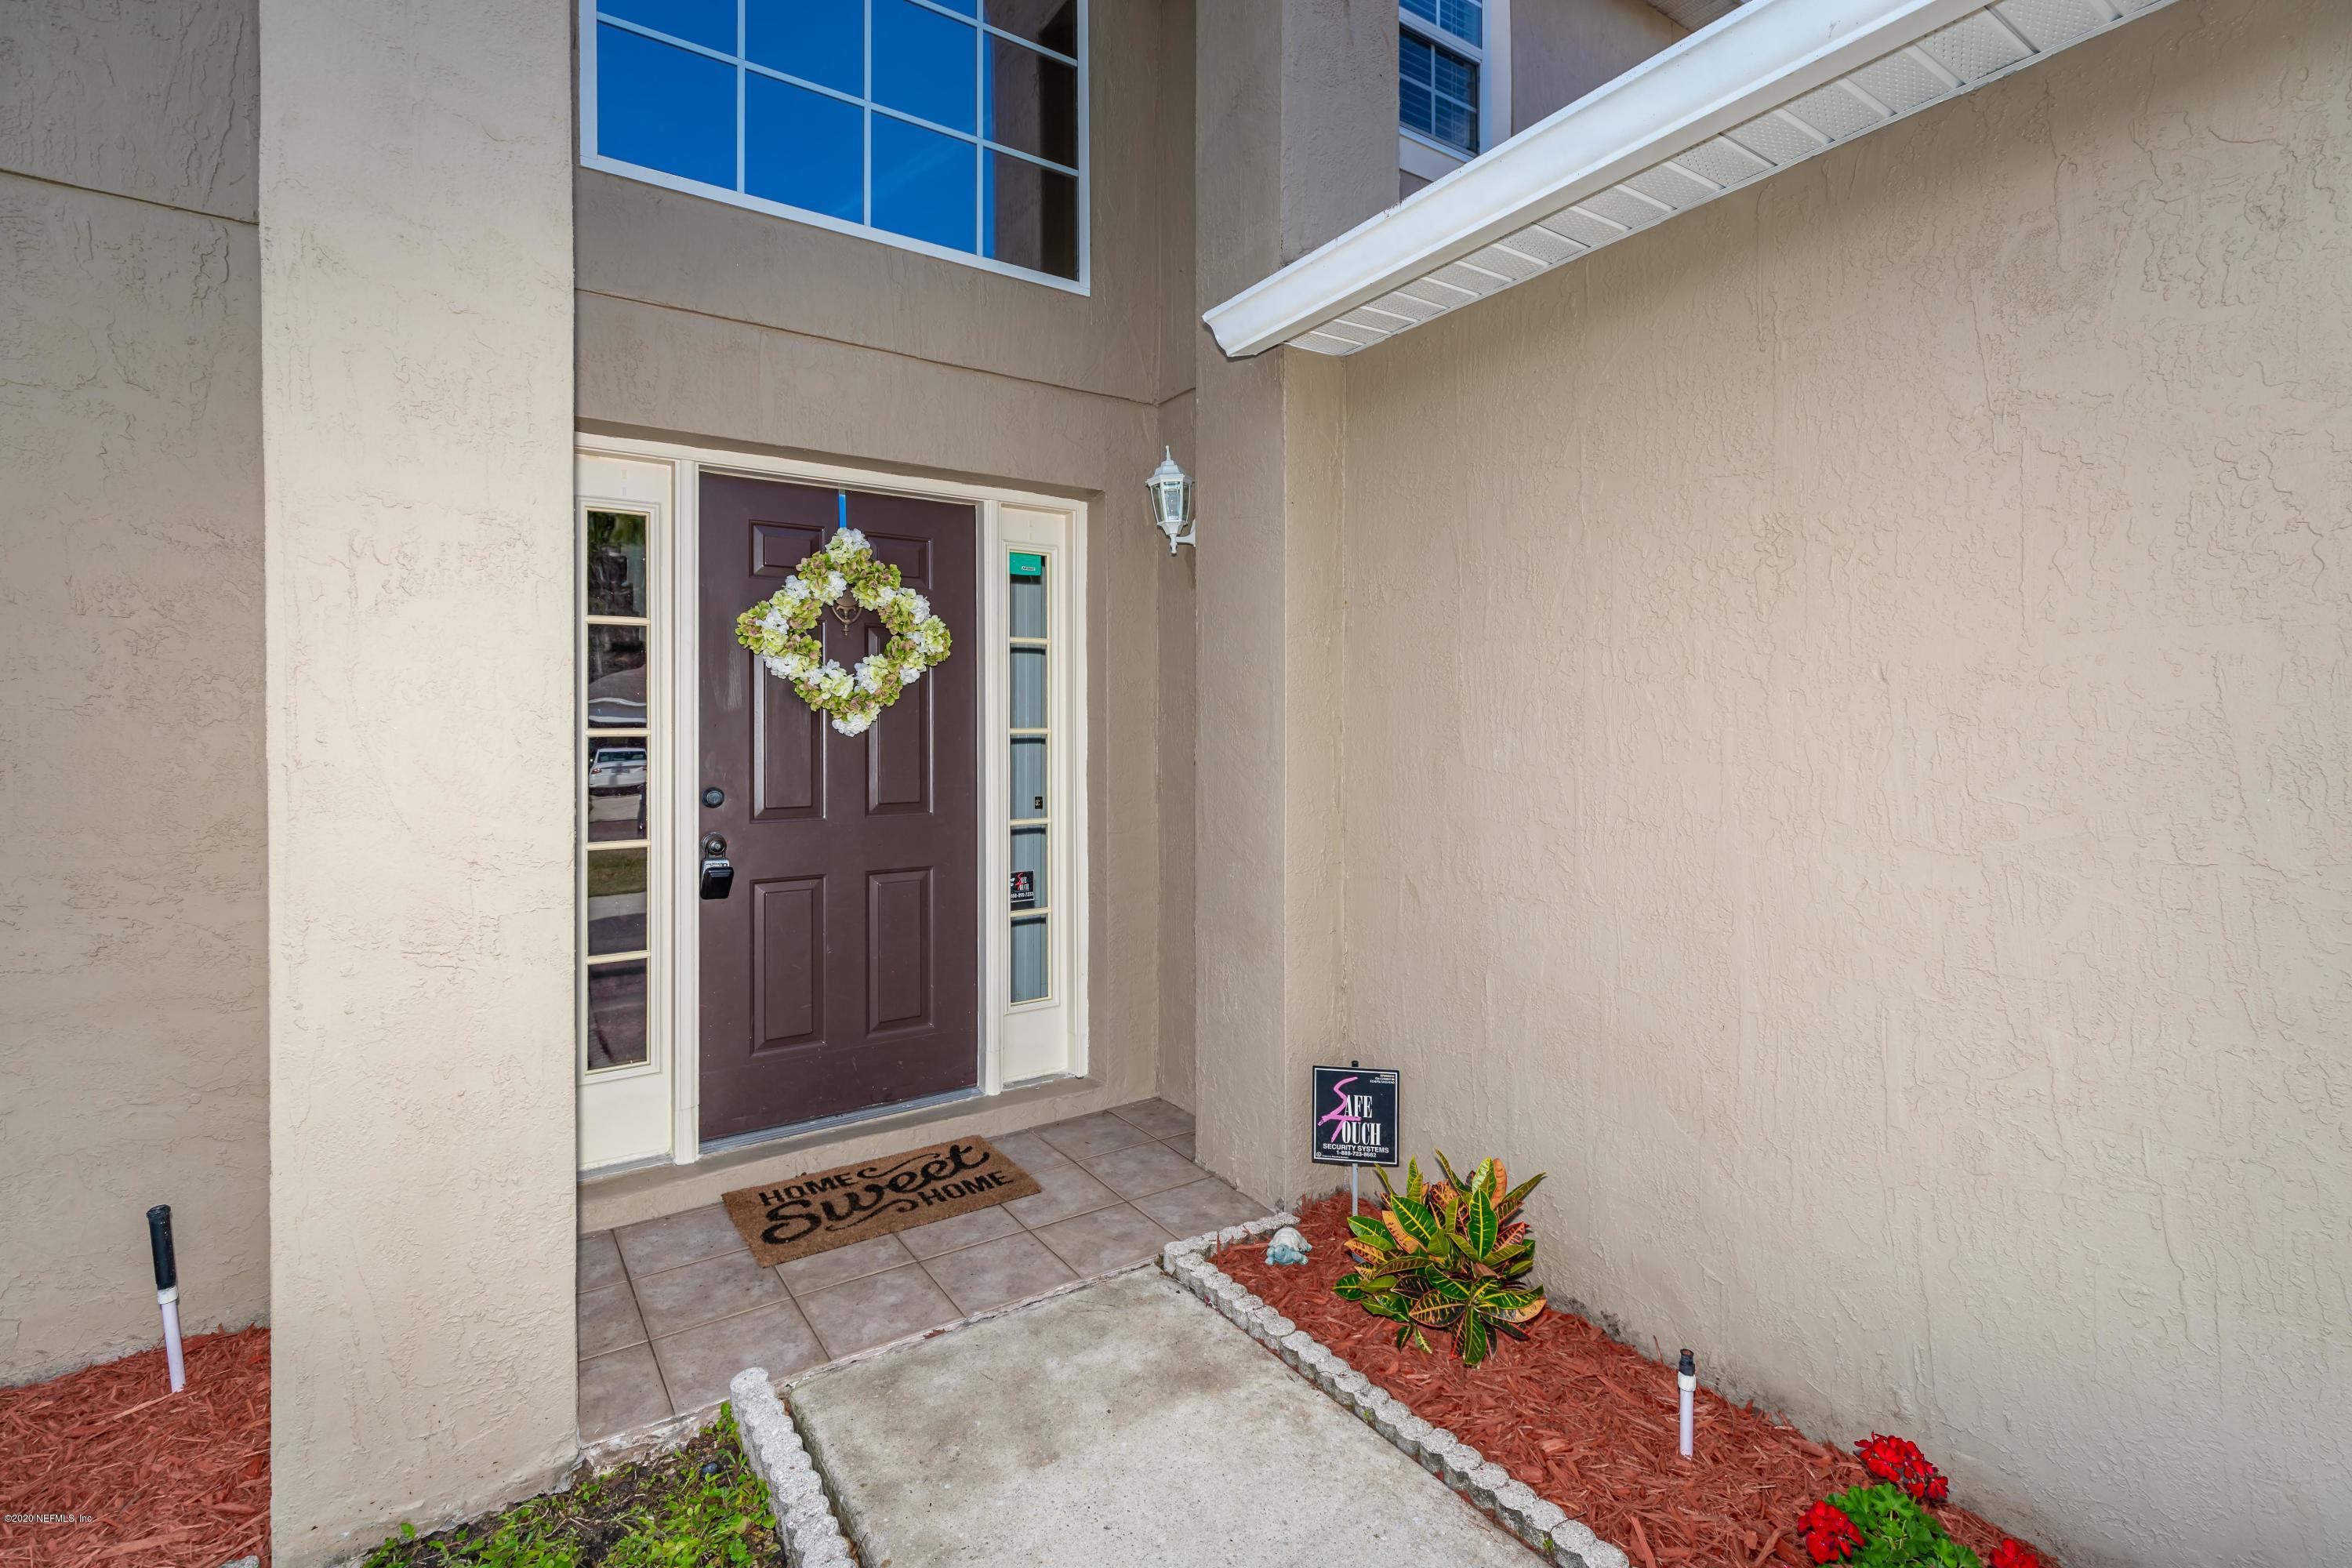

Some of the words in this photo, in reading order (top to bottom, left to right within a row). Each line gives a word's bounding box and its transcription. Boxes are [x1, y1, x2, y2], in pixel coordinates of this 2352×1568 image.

[1318, 1076, 1373, 1126] SAFE
[1321, 1114, 1381, 1145] TOUCH
[1323, 1143, 1356, 1152] SECURITY
[757, 1172, 856, 1207] HOME
[759, 1144, 990, 1245] Sweet
[916, 1170, 1014, 1207] HOME
